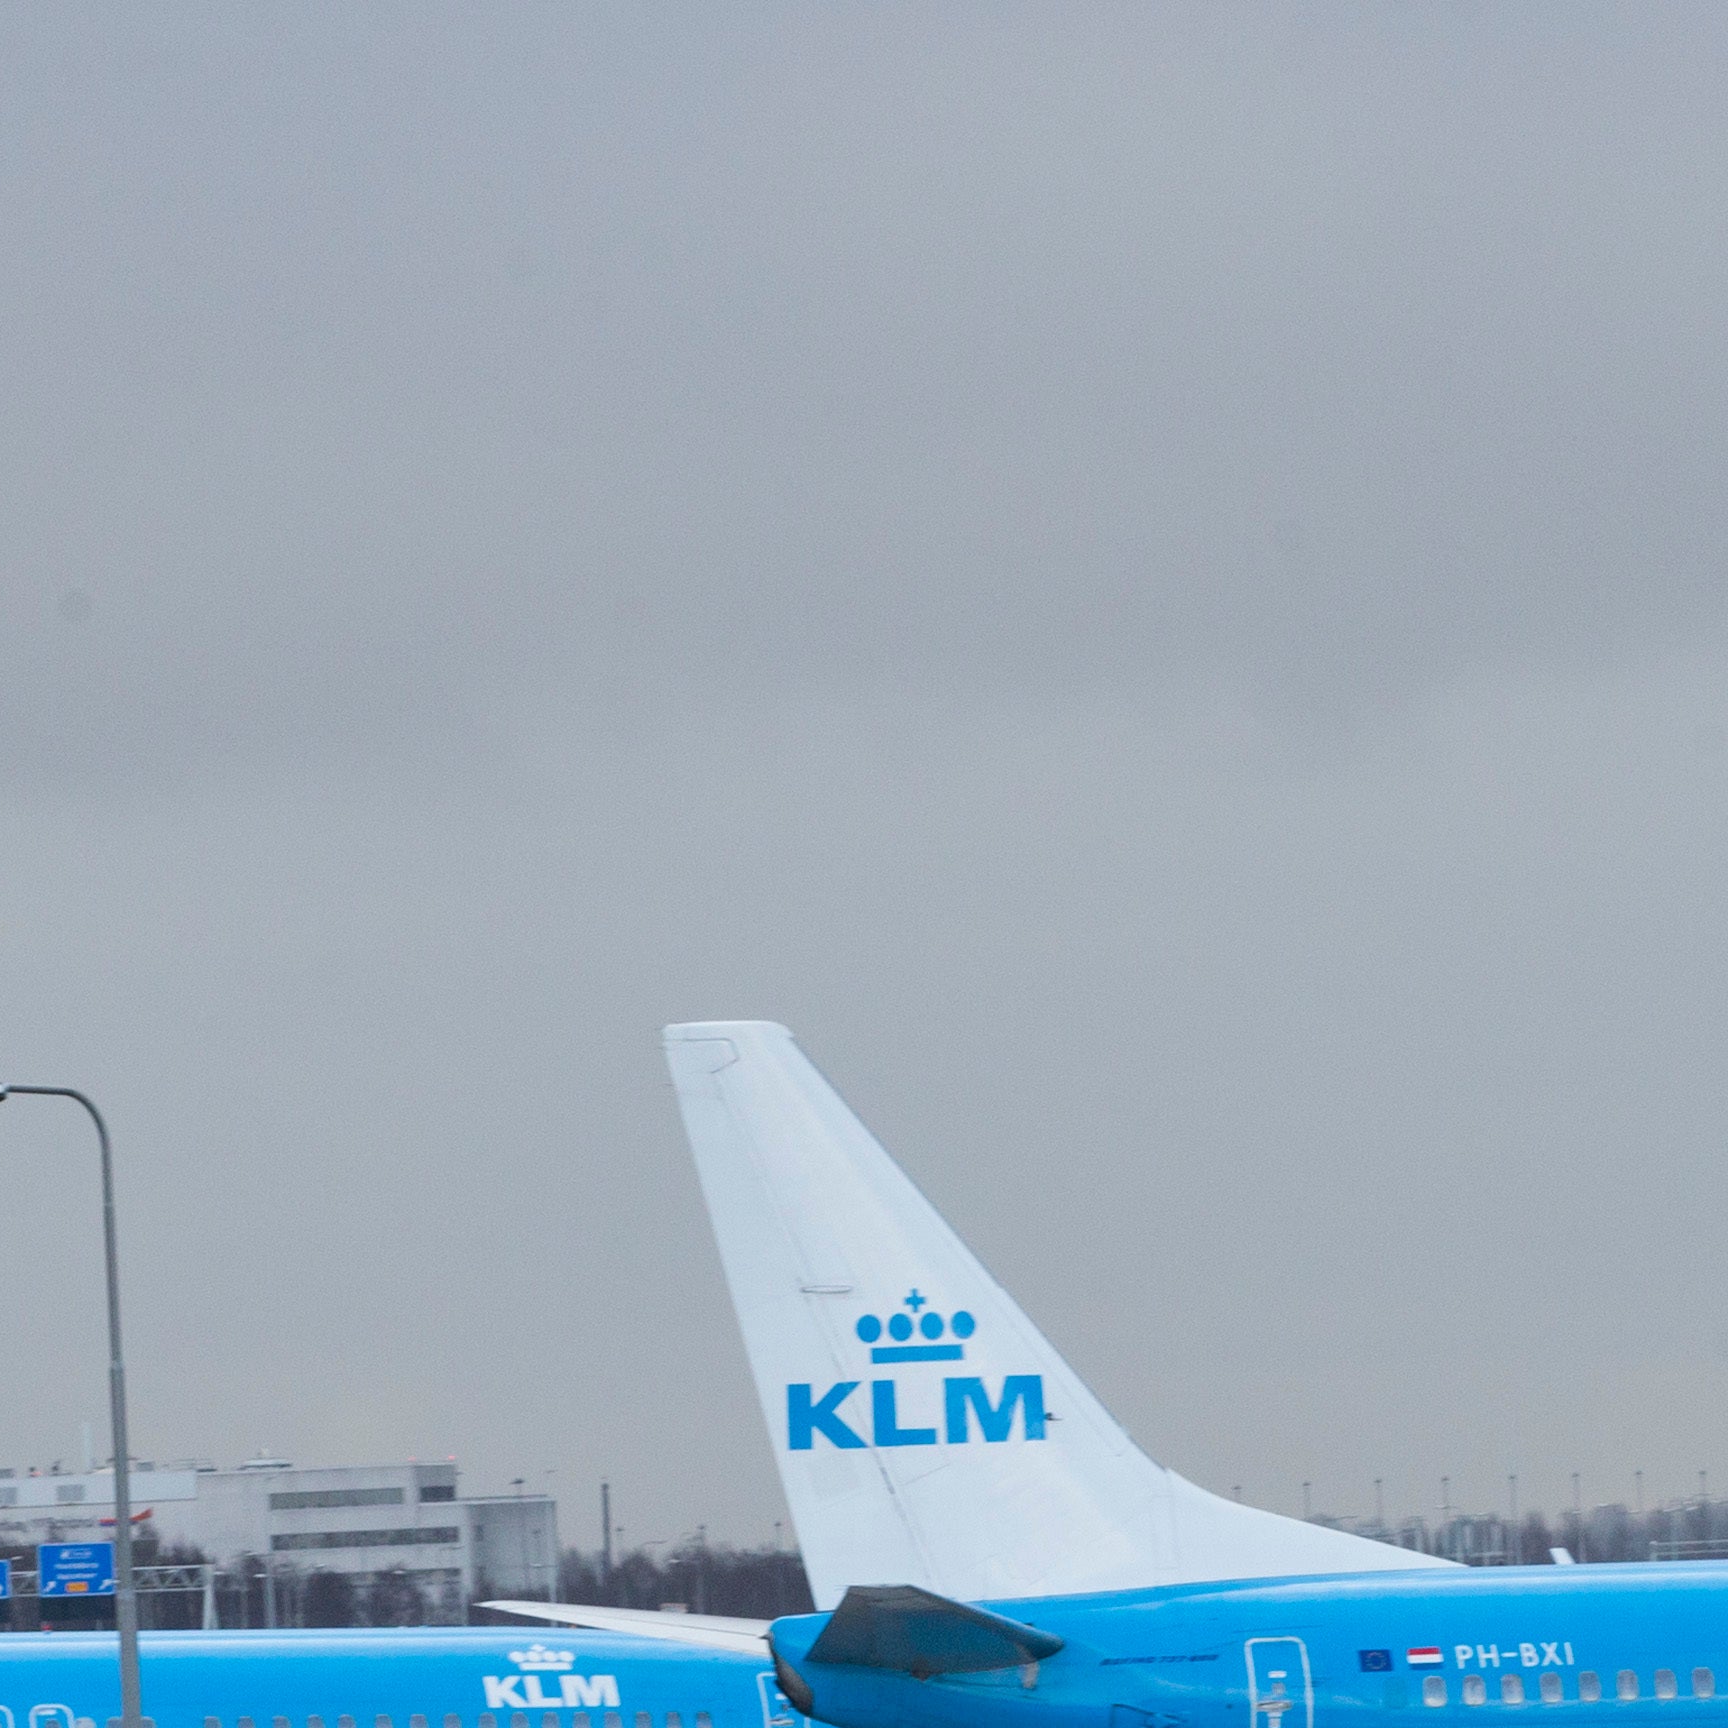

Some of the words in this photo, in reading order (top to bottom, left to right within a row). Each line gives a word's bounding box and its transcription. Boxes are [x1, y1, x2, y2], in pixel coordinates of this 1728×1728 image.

[787, 1375, 1046, 1451] KLM
[1454, 1641, 1575, 1670] PH-BXI
[482, 1674, 621, 1708] KLM
